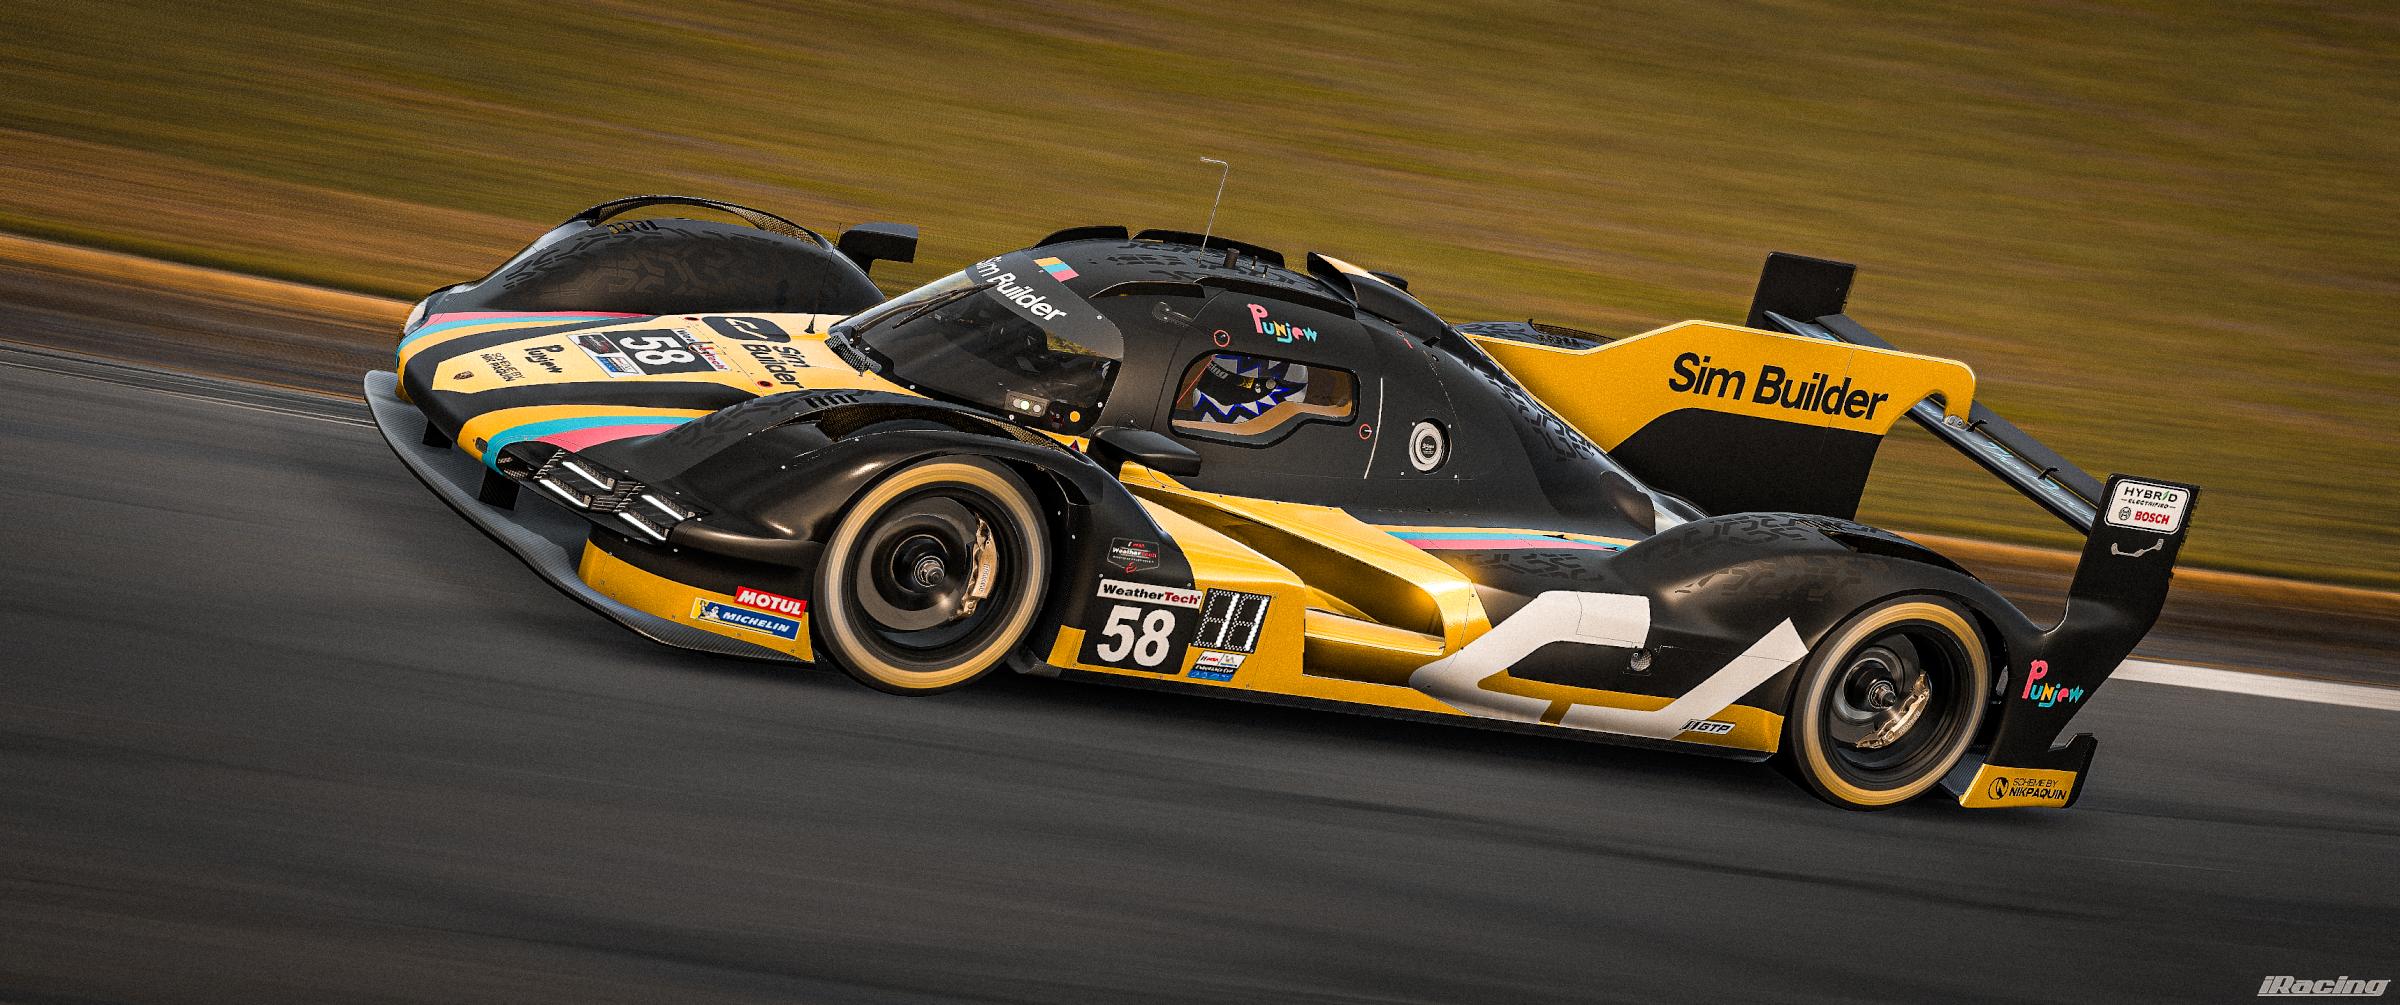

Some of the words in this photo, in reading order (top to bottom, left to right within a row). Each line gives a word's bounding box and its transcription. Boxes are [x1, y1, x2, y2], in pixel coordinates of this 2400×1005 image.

[986, 272, 1067, 320] Builder
[619, 336, 695, 366] 58
[772, 346, 811, 367] Sim
[741, 344, 804, 388] Builder
[1669, 352, 1746, 400] Sim
[1752, 364, 1888, 420] Builder
[2124, 487, 2178, 502] HYBRID
[2128, 499, 2169, 509] ELECTRIFIED
[2134, 511, 2170, 525] BOSCH
[737, 590, 801, 615] MOTUL
[723, 611, 790, 632] MICHELIN
[1097, 605, 1176, 667] 58
[1698, 722, 1731, 732] GTP
[2009, 787, 2067, 799] NIKPAQUIN
[2013, 778, 2045, 787] SCHEME
[2046, 779, 2058, 788] BY
